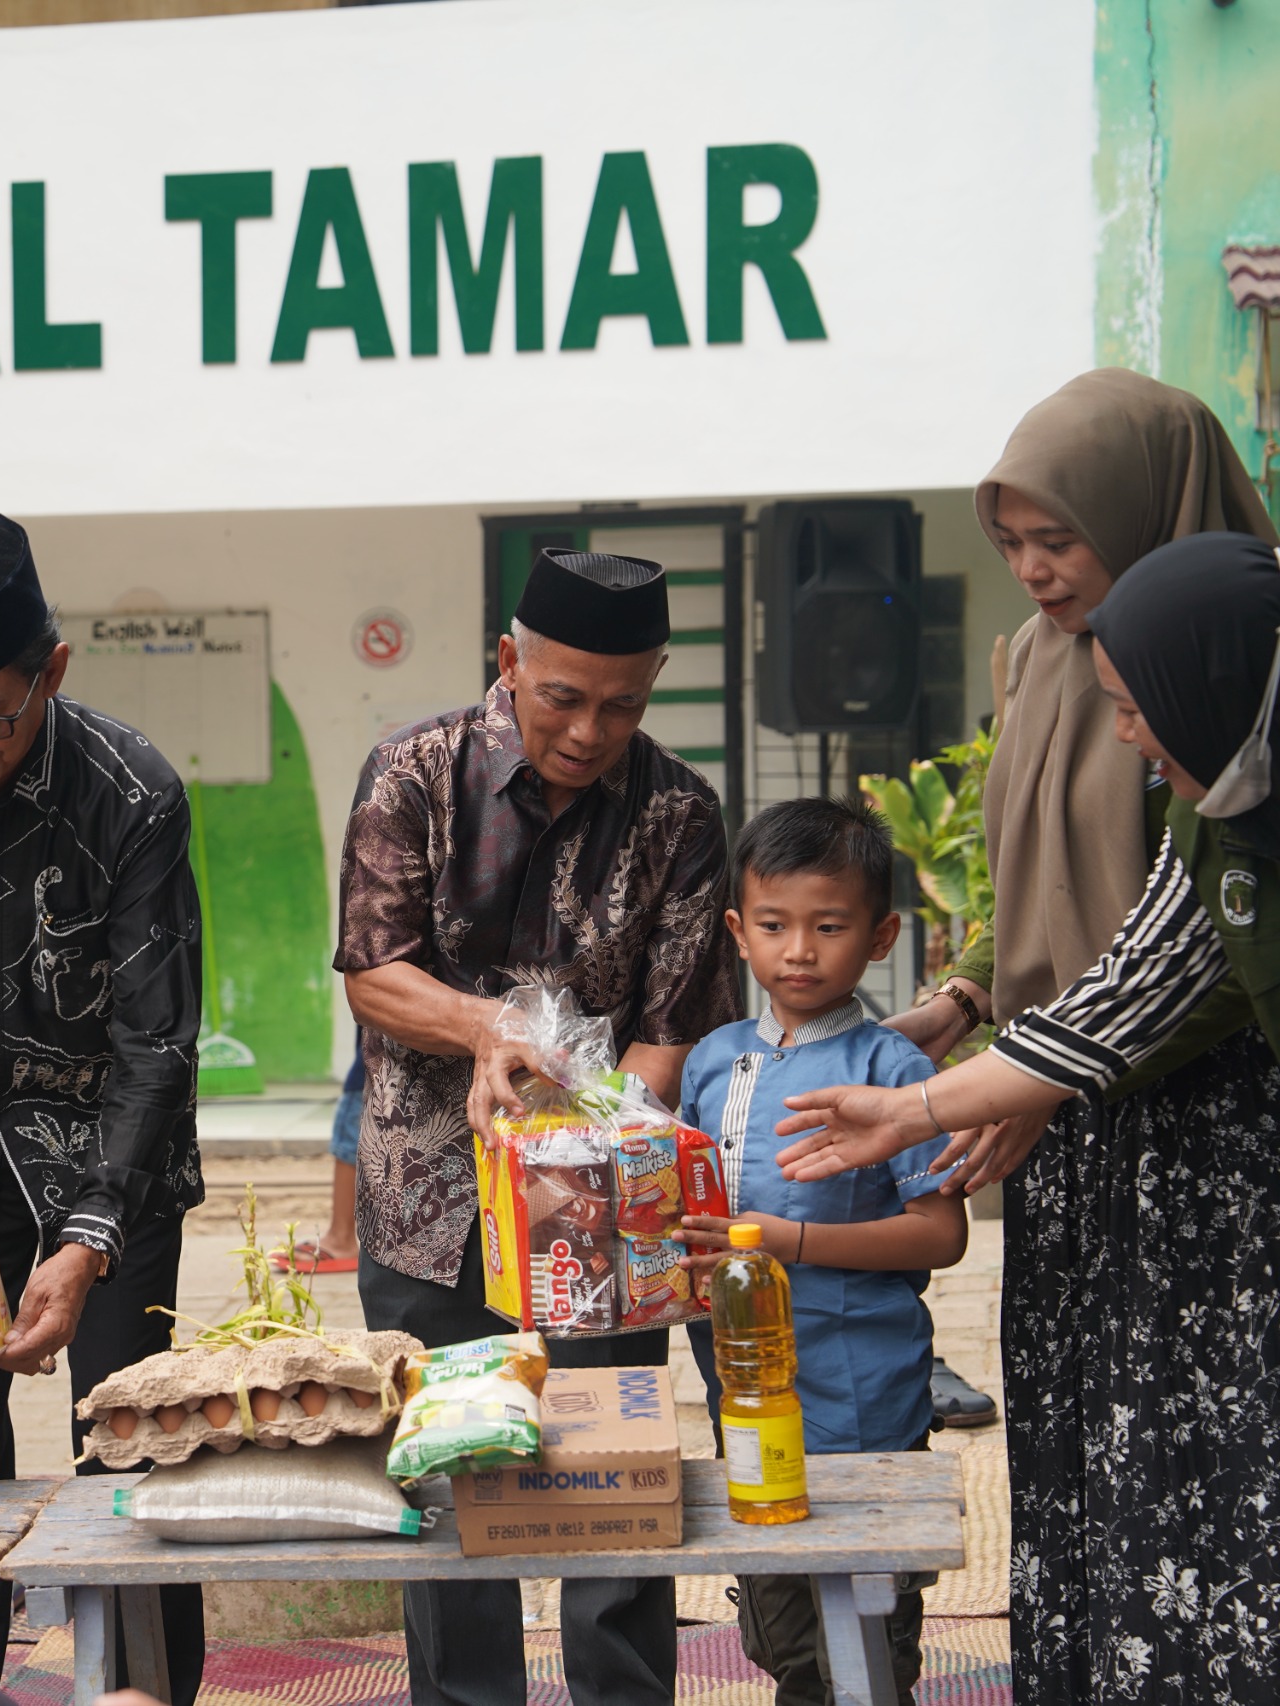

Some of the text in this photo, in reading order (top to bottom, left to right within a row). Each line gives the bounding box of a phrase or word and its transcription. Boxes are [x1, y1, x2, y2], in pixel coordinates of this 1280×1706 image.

[164, 141, 829, 365] TAMAR
[624, 1144, 648, 1152] Roma
[622, 1150, 672, 1181] Malkist
[693, 1162, 706, 1200] Roma
[634, 1243, 658, 1252] Roma
[632, 1249, 681, 1281] Malkist
[548, 1240, 582, 1323] Tango
[445, 1341, 490, 1360] Larisst
[617, 1370, 661, 1420] INDOMILK
[518, 1471, 622, 1490] INDOMILK
[639, 1518, 659, 1533] PSR
